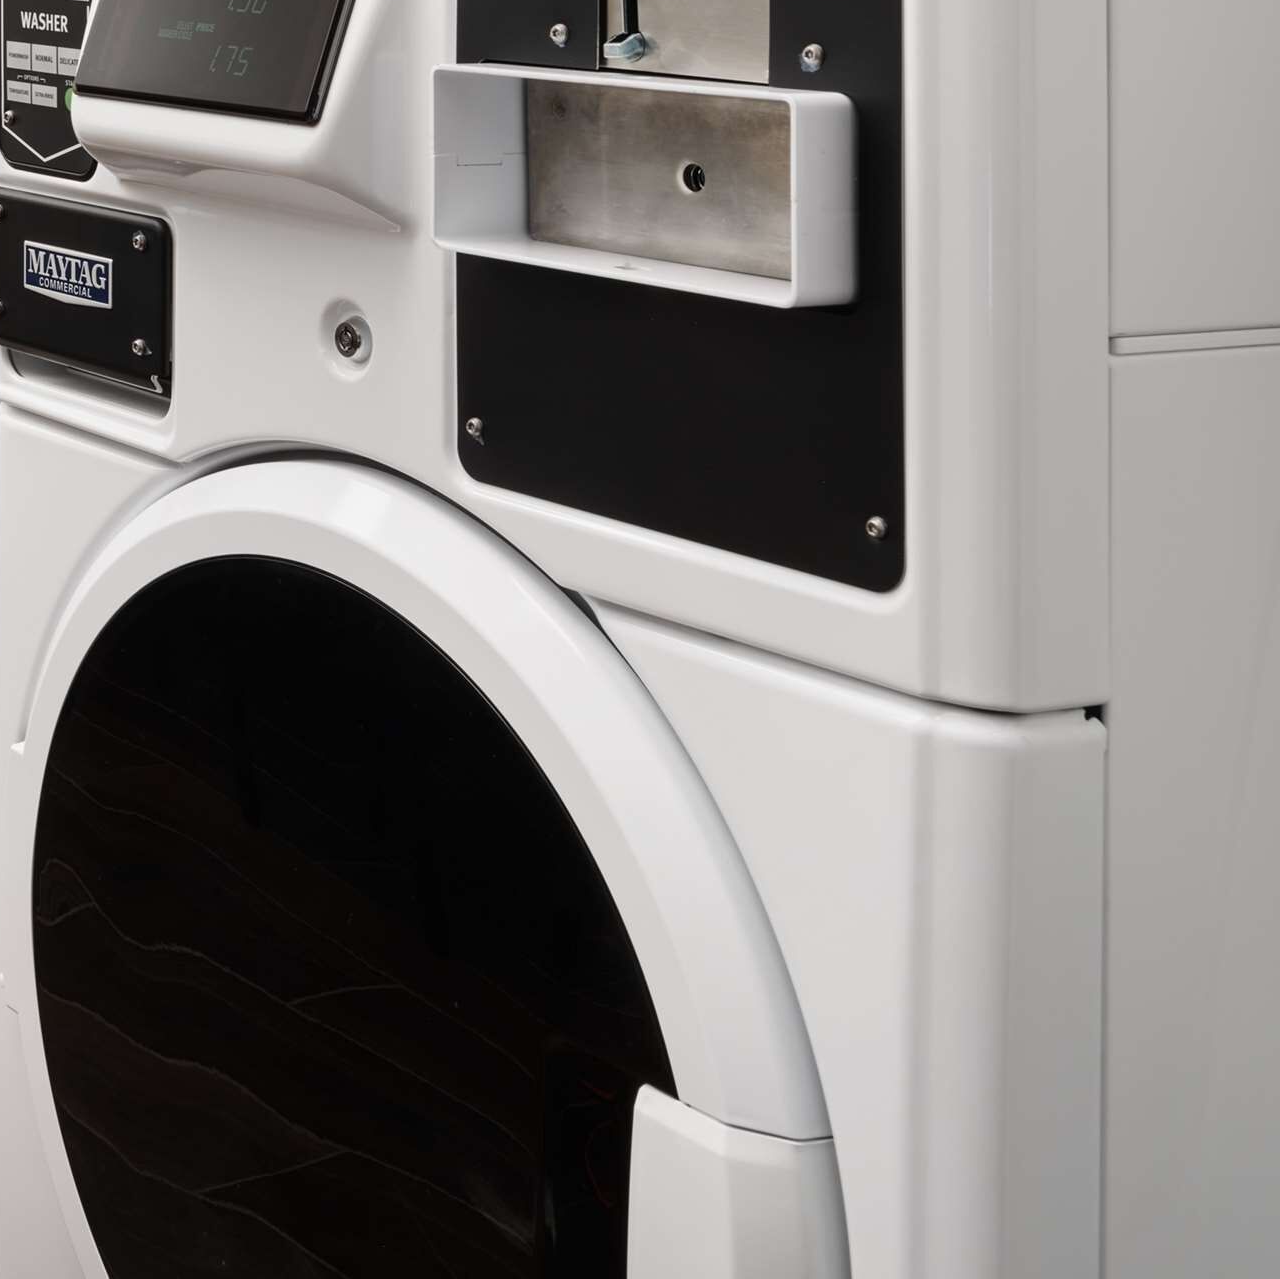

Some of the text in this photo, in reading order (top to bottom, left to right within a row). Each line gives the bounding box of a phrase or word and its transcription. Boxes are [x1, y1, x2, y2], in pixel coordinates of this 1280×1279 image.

[20, 10, 69, 33] WASHER
[27, 247, 107, 291] MAYTAG
[38, 276, 92, 299] COMMERCIAL
